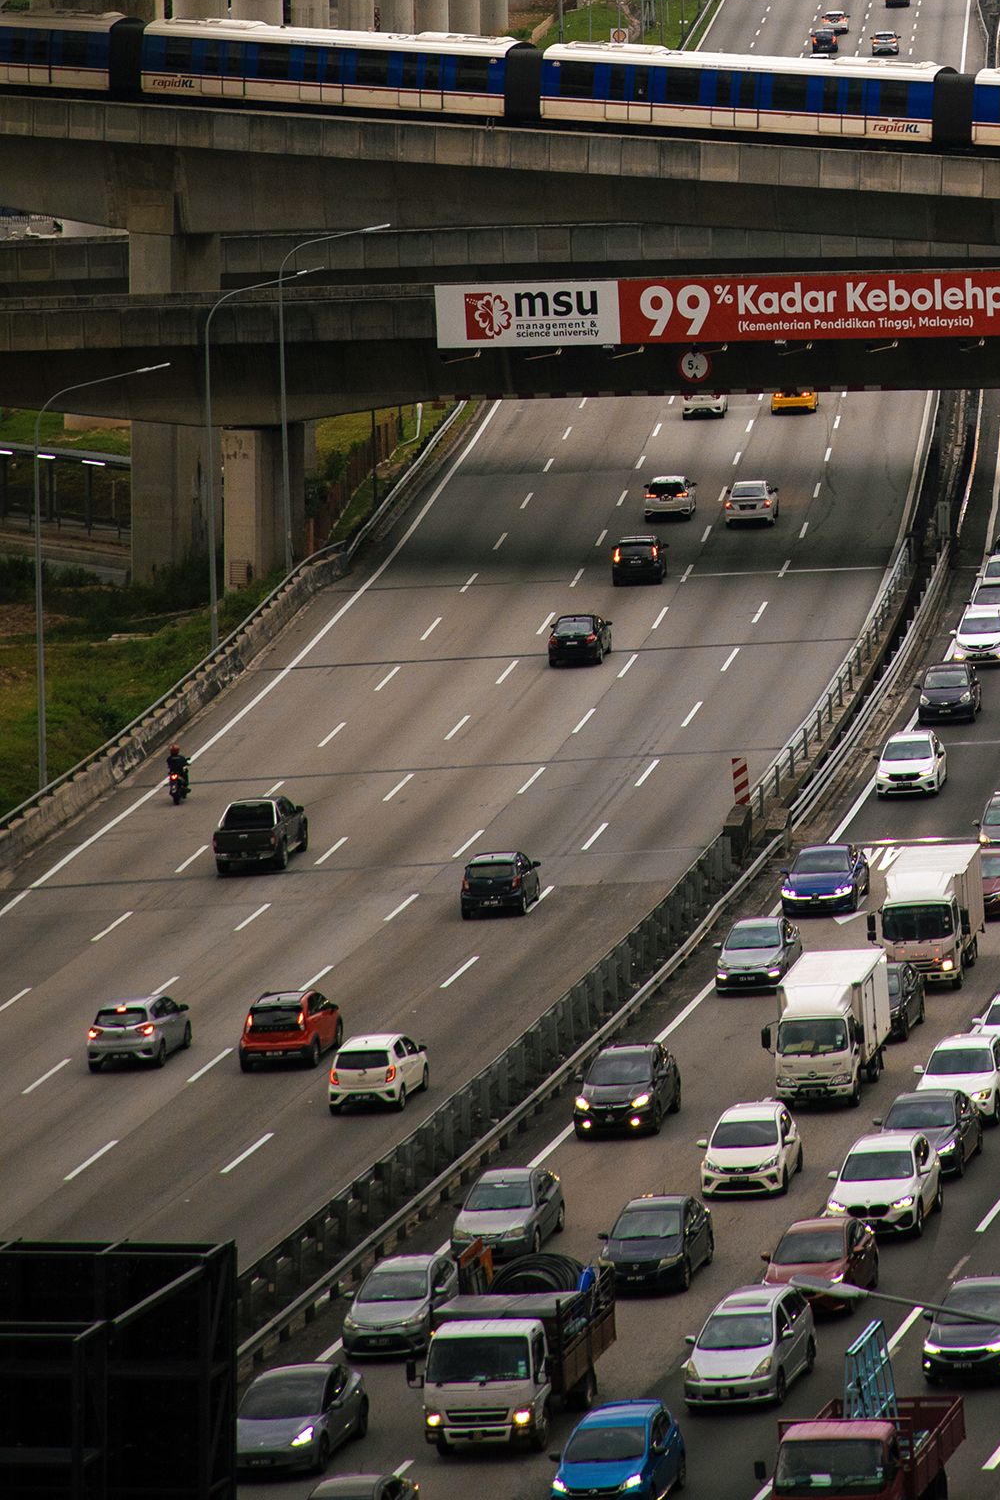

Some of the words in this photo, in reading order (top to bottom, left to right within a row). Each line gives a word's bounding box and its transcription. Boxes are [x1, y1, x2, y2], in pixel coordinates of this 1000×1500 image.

[152, 78, 195, 89] rapidKL
[873, 122, 920, 134] rapidKL
[514, 290, 599, 318] msu
[737, 282, 838, 315] Kadar
[516, 321, 586, 332] management
[590, 320, 597, 328] &
[738, 319, 811, 333] (Kementerian
[814, 317, 876, 330] Pendidikan
[878, 316, 916, 331] Tinggi,
[918, 315, 974, 330] Malaysia)
[516, 330, 550, 338] science
[553, 328, 600, 338] university
